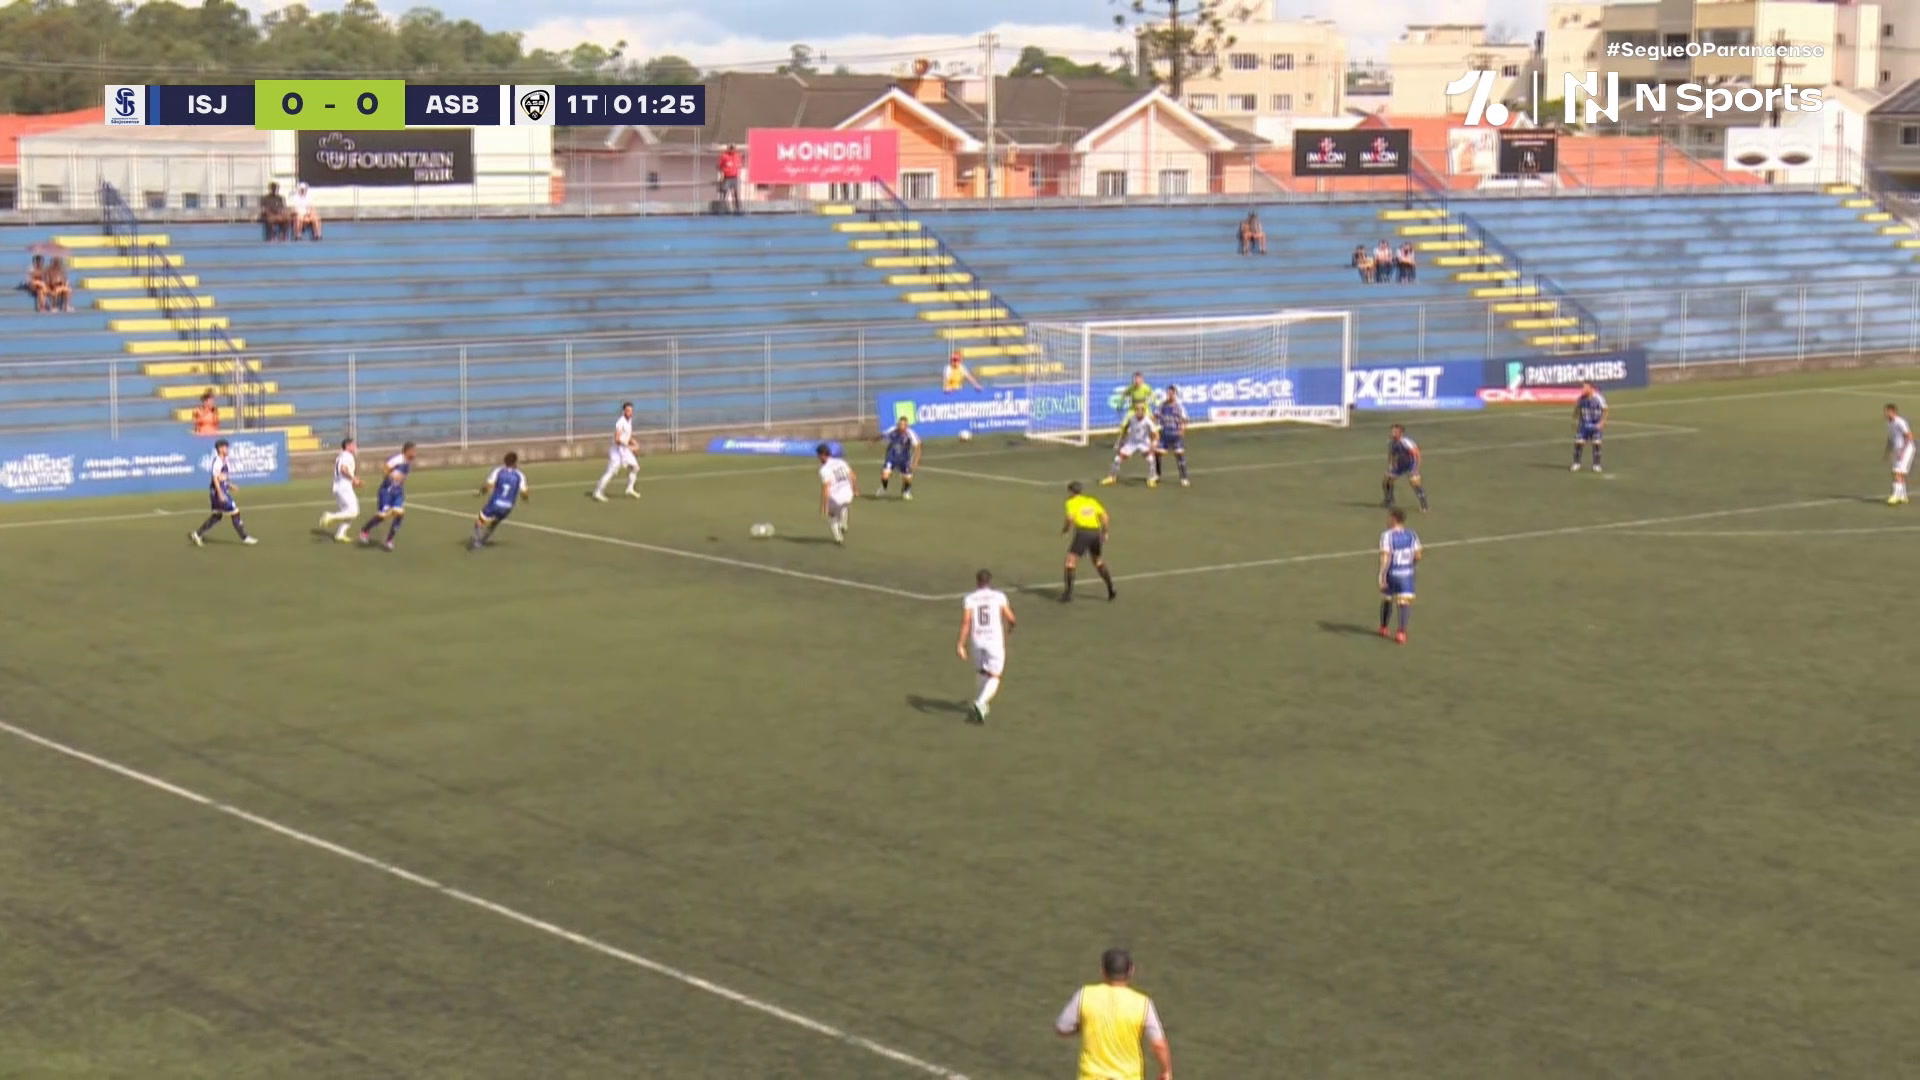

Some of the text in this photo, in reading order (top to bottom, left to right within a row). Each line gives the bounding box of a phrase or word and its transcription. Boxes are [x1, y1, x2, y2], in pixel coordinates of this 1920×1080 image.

[1211, 381, 1235, 401] da
[1238, 378, 1293, 399] Sorte
[977, 605, 991, 627] 6
